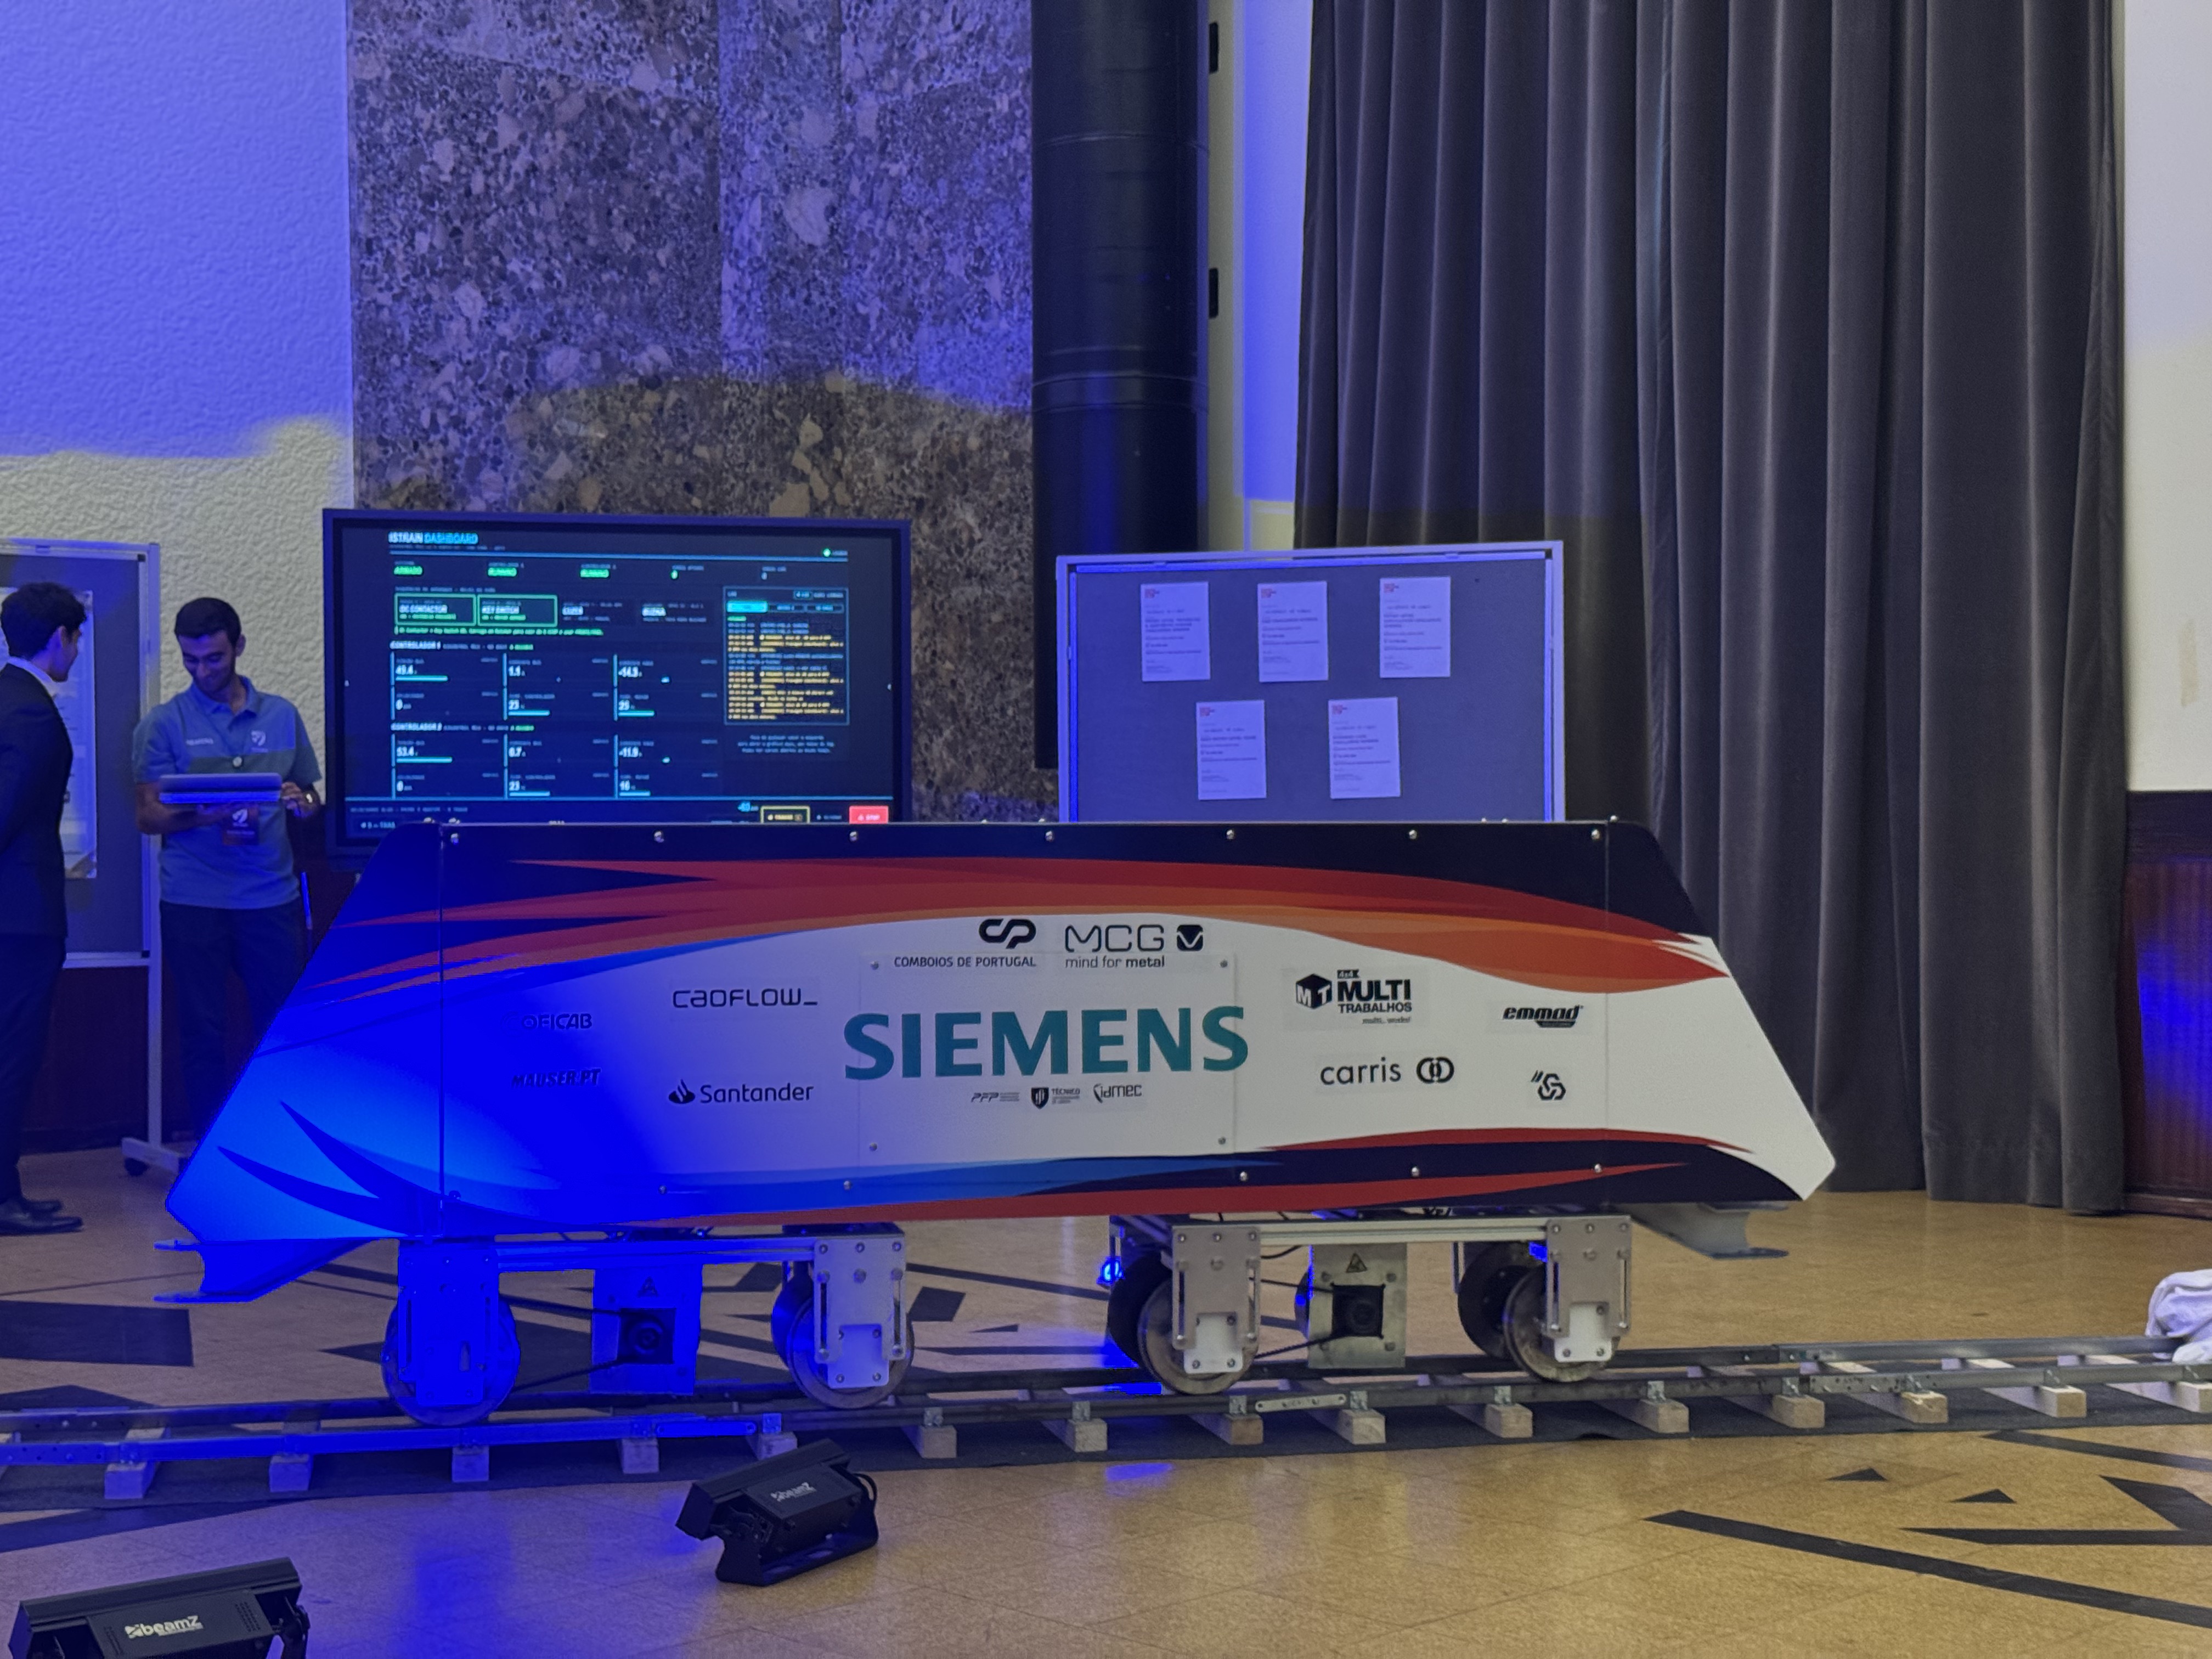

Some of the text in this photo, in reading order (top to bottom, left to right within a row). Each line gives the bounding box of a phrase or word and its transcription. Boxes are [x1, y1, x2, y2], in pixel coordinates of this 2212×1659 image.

[424, 532, 478, 544] DASHBOARD
[1065, 924, 1165, 952] MCG
[894, 956, 1036, 967] COMBOIOS DE PORTUGAL
[1065, 956, 1165, 968] mind for metal
[1338, 979, 1411, 1002] MULTI
[1338, 1002, 1412, 1014] TRABALHOS
[1503, 1005, 1580, 1020] emmad
[522, 1013, 592, 1030] OFICAB
[844, 1006, 1249, 1080] SIEMENS
[1320, 1057, 1401, 1085] carris
[700, 1082, 814, 1104] Santander
